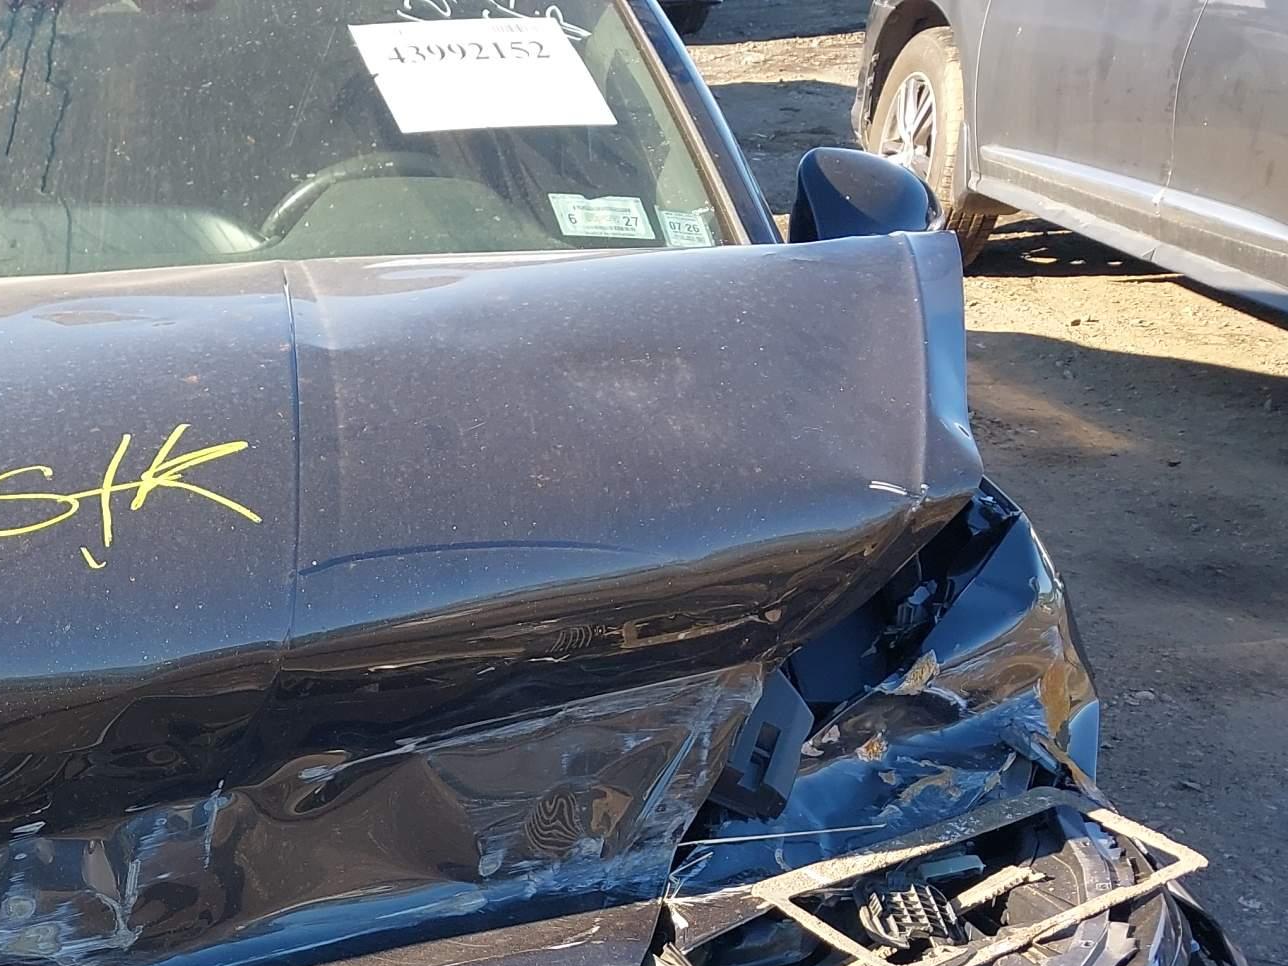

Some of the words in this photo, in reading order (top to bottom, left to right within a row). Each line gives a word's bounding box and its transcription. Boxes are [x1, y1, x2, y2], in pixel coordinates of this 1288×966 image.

[389, 41, 551, 63] 43992152
[567, 213, 578, 225] 6
[622, 215, 639, 227] 27
[668, 221, 681, 231] 07
